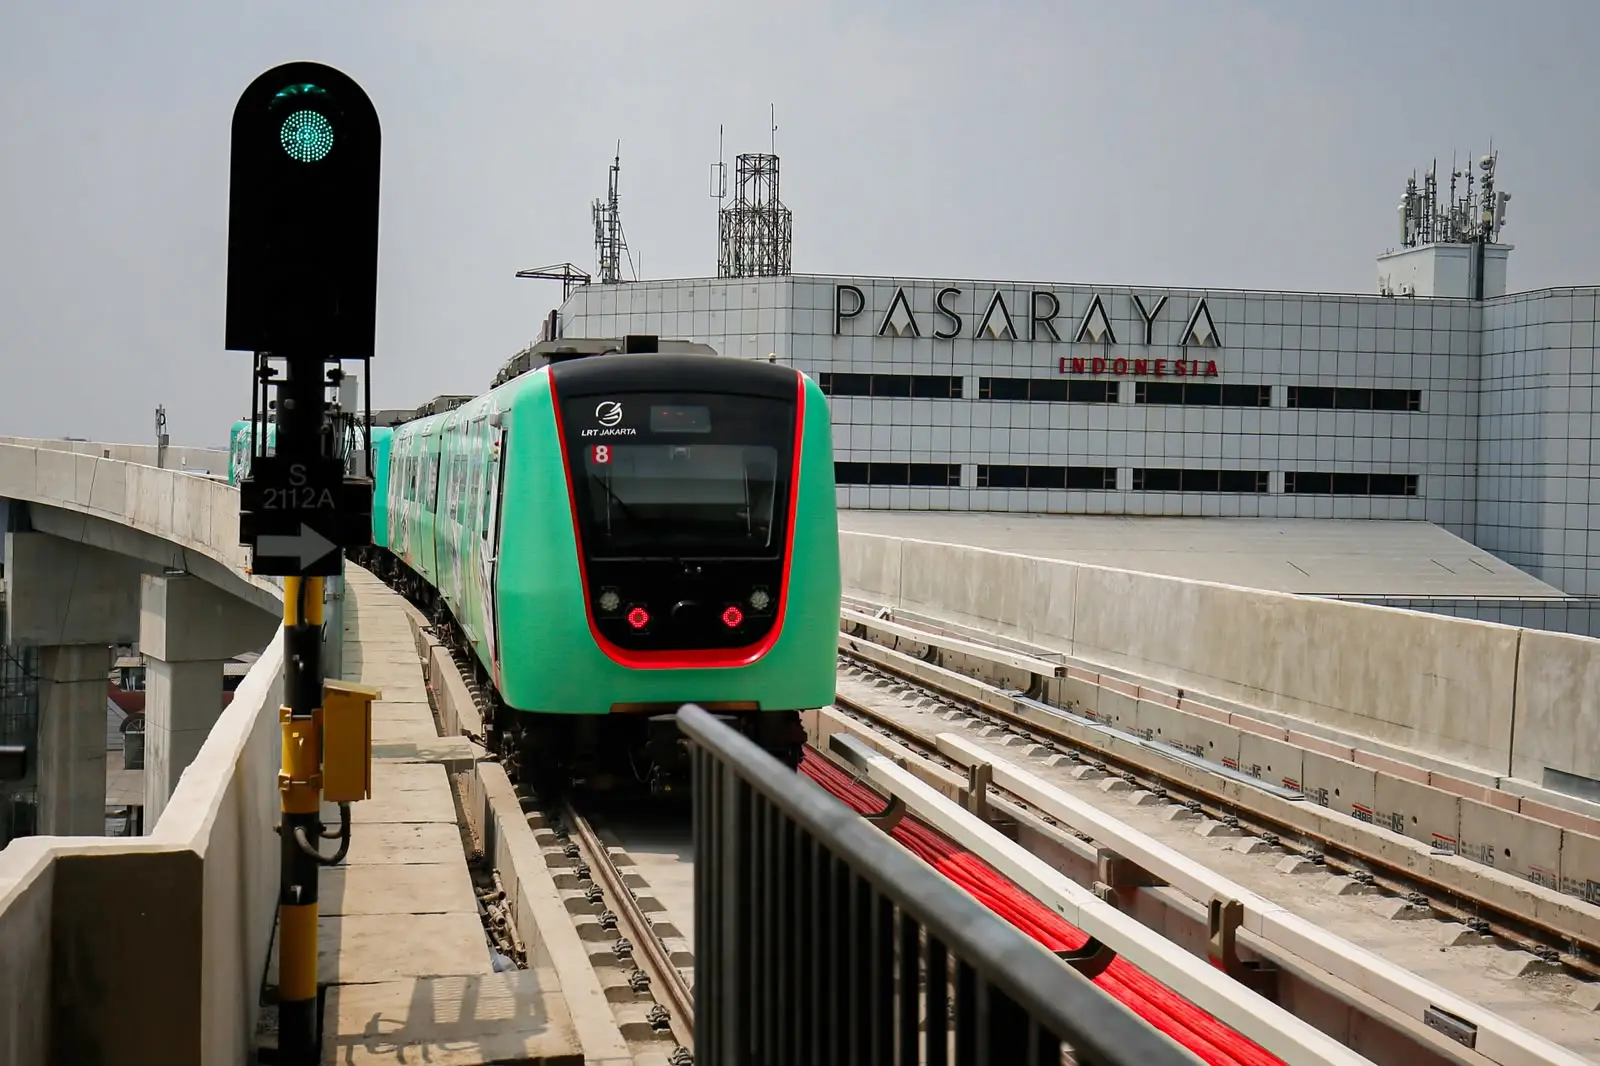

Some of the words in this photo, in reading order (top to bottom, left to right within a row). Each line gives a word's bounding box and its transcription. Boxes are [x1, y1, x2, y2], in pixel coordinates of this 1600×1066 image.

[834, 284, 1222, 347] PASARAYA
[1060, 356, 1219, 378] INDONESIA
[581, 429, 599, 437] LRT
[599, 428, 637, 437] JAKARTA
[595, 445, 609, 463] 8
[288, 463, 307, 486] S
[262, 487, 336, 510] 2112A
